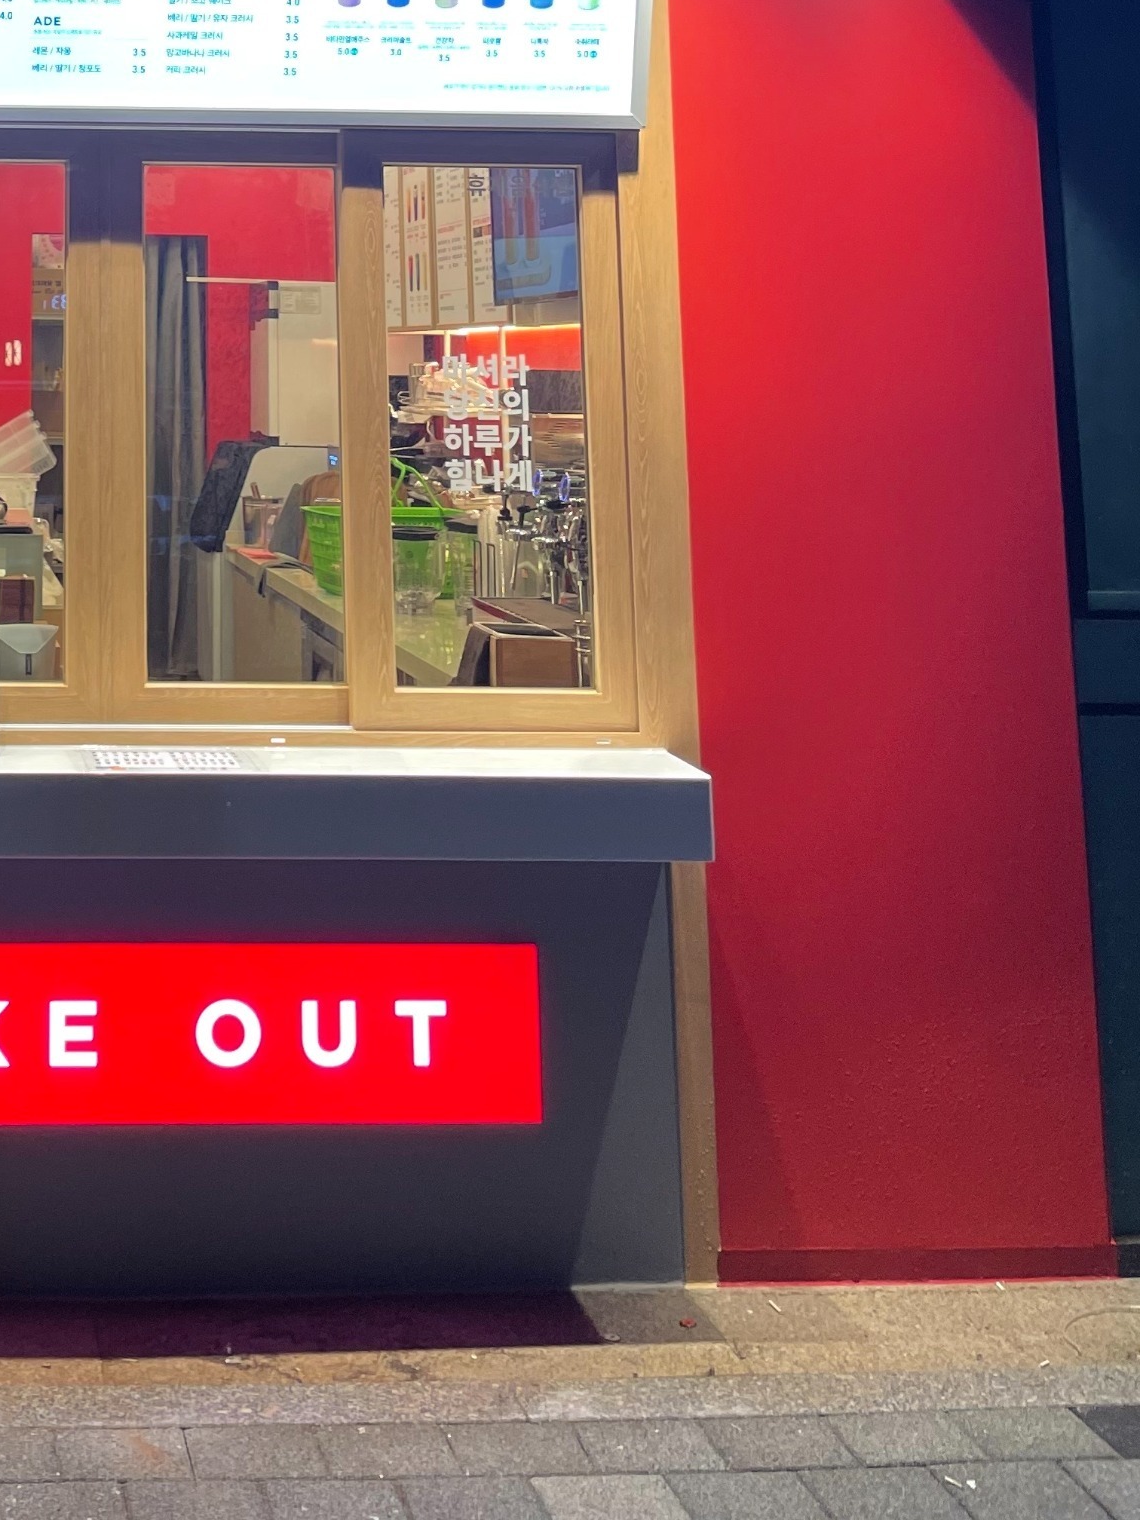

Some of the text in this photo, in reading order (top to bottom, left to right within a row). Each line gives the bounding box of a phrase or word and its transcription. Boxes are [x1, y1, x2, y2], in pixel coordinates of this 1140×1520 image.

[34, 17, 60, 26] ADE
[286, 16, 299, 24] 3.5
[284, 50, 297, 58] 3.5
[443, 423, 533, 458] 하루가
[444, 458, 534, 492] 힘나게
[193, 998, 448, 1069] OUT
